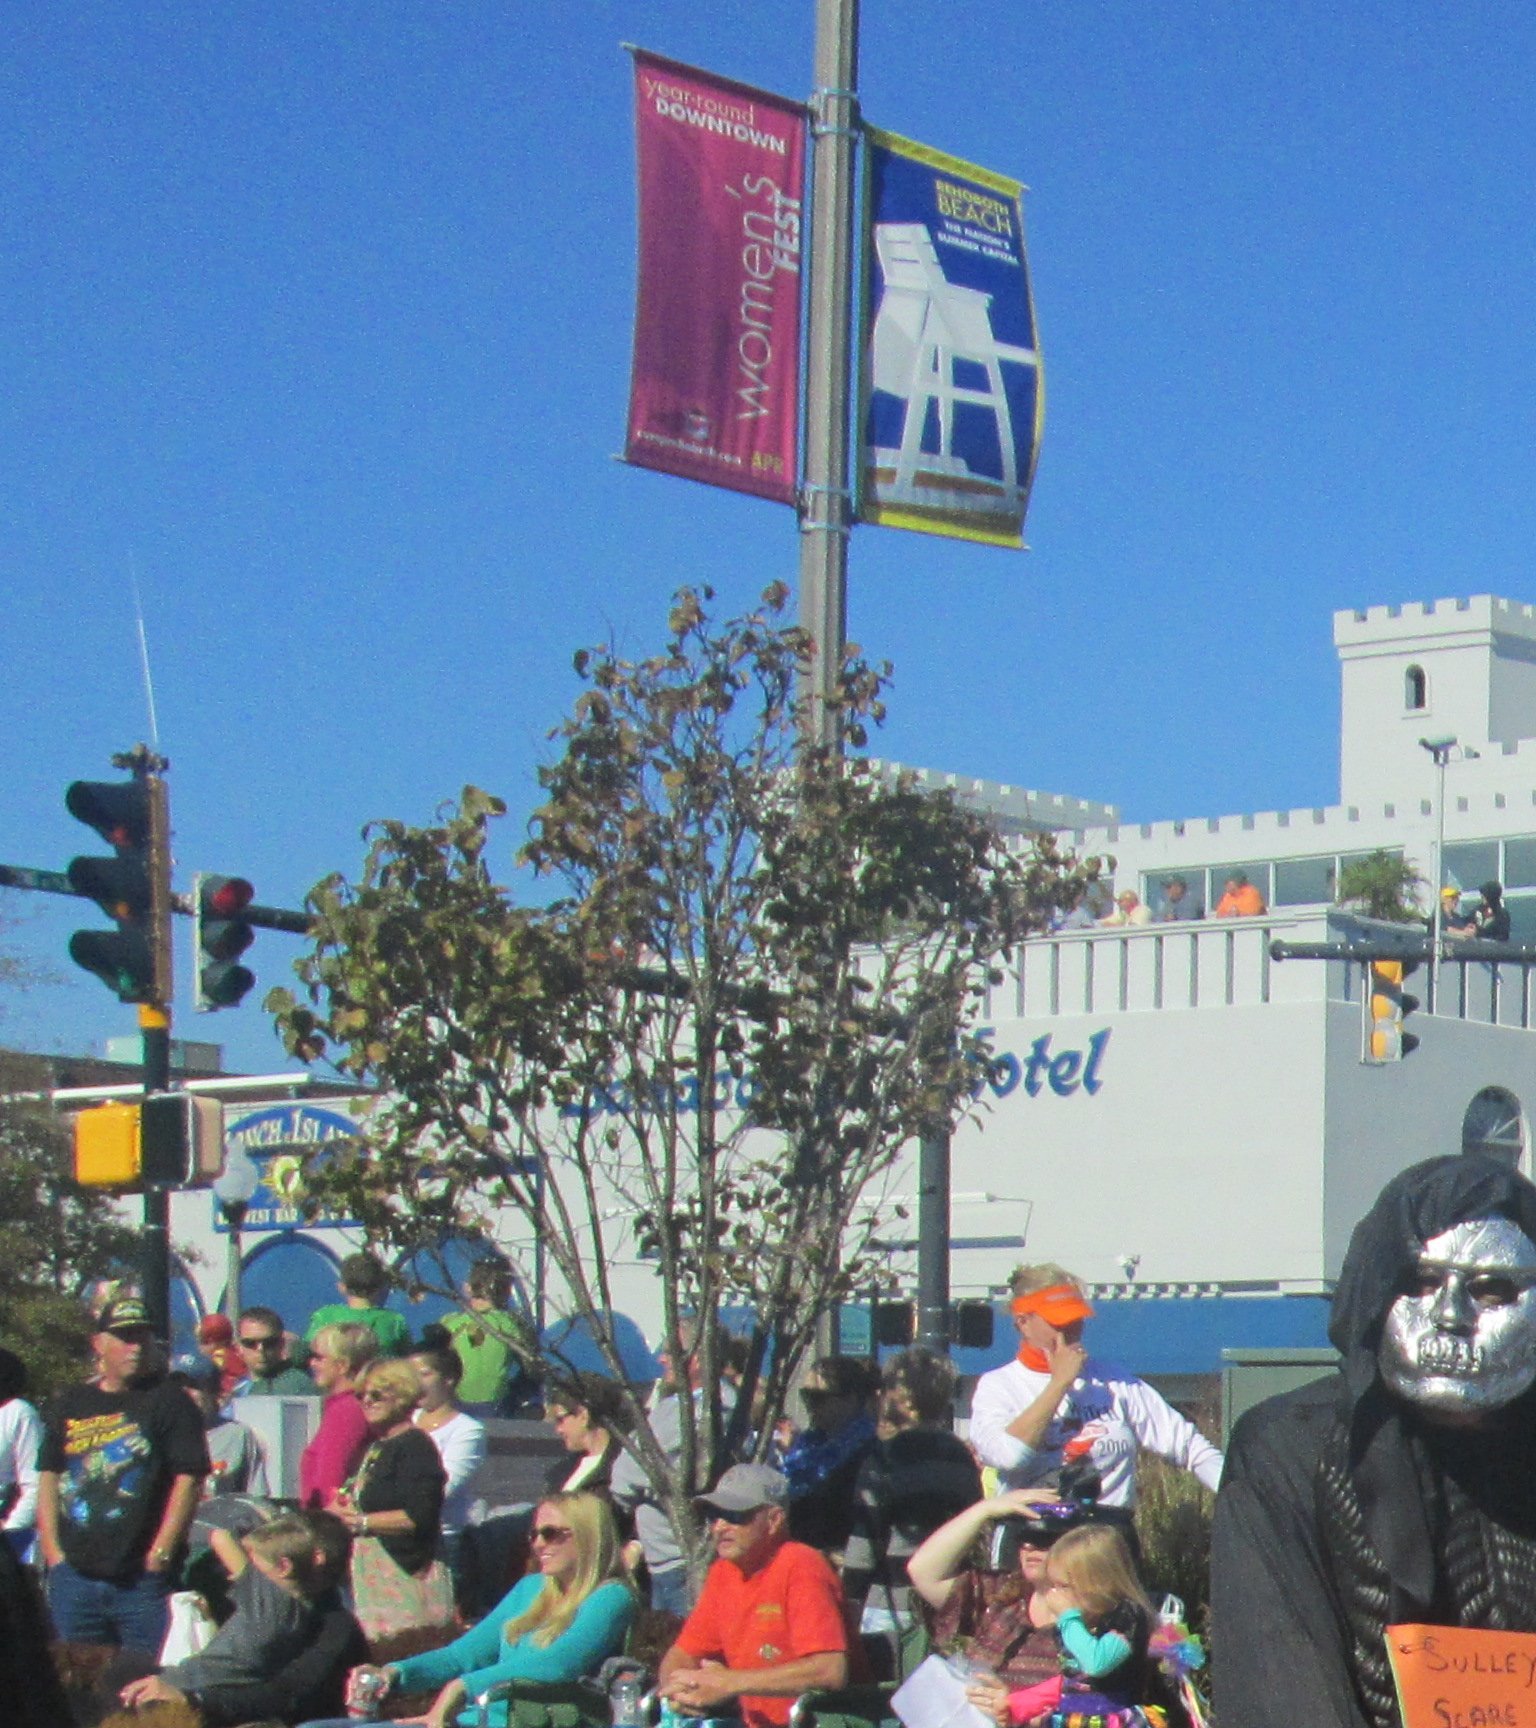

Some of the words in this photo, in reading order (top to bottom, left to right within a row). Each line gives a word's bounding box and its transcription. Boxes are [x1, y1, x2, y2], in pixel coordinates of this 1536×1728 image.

[656, 97, 786, 154] DOWNTOWN
[768, 188, 800, 272] FEST
[939, 194, 1013, 239] BEACH
[724, 173, 776, 421] women's
